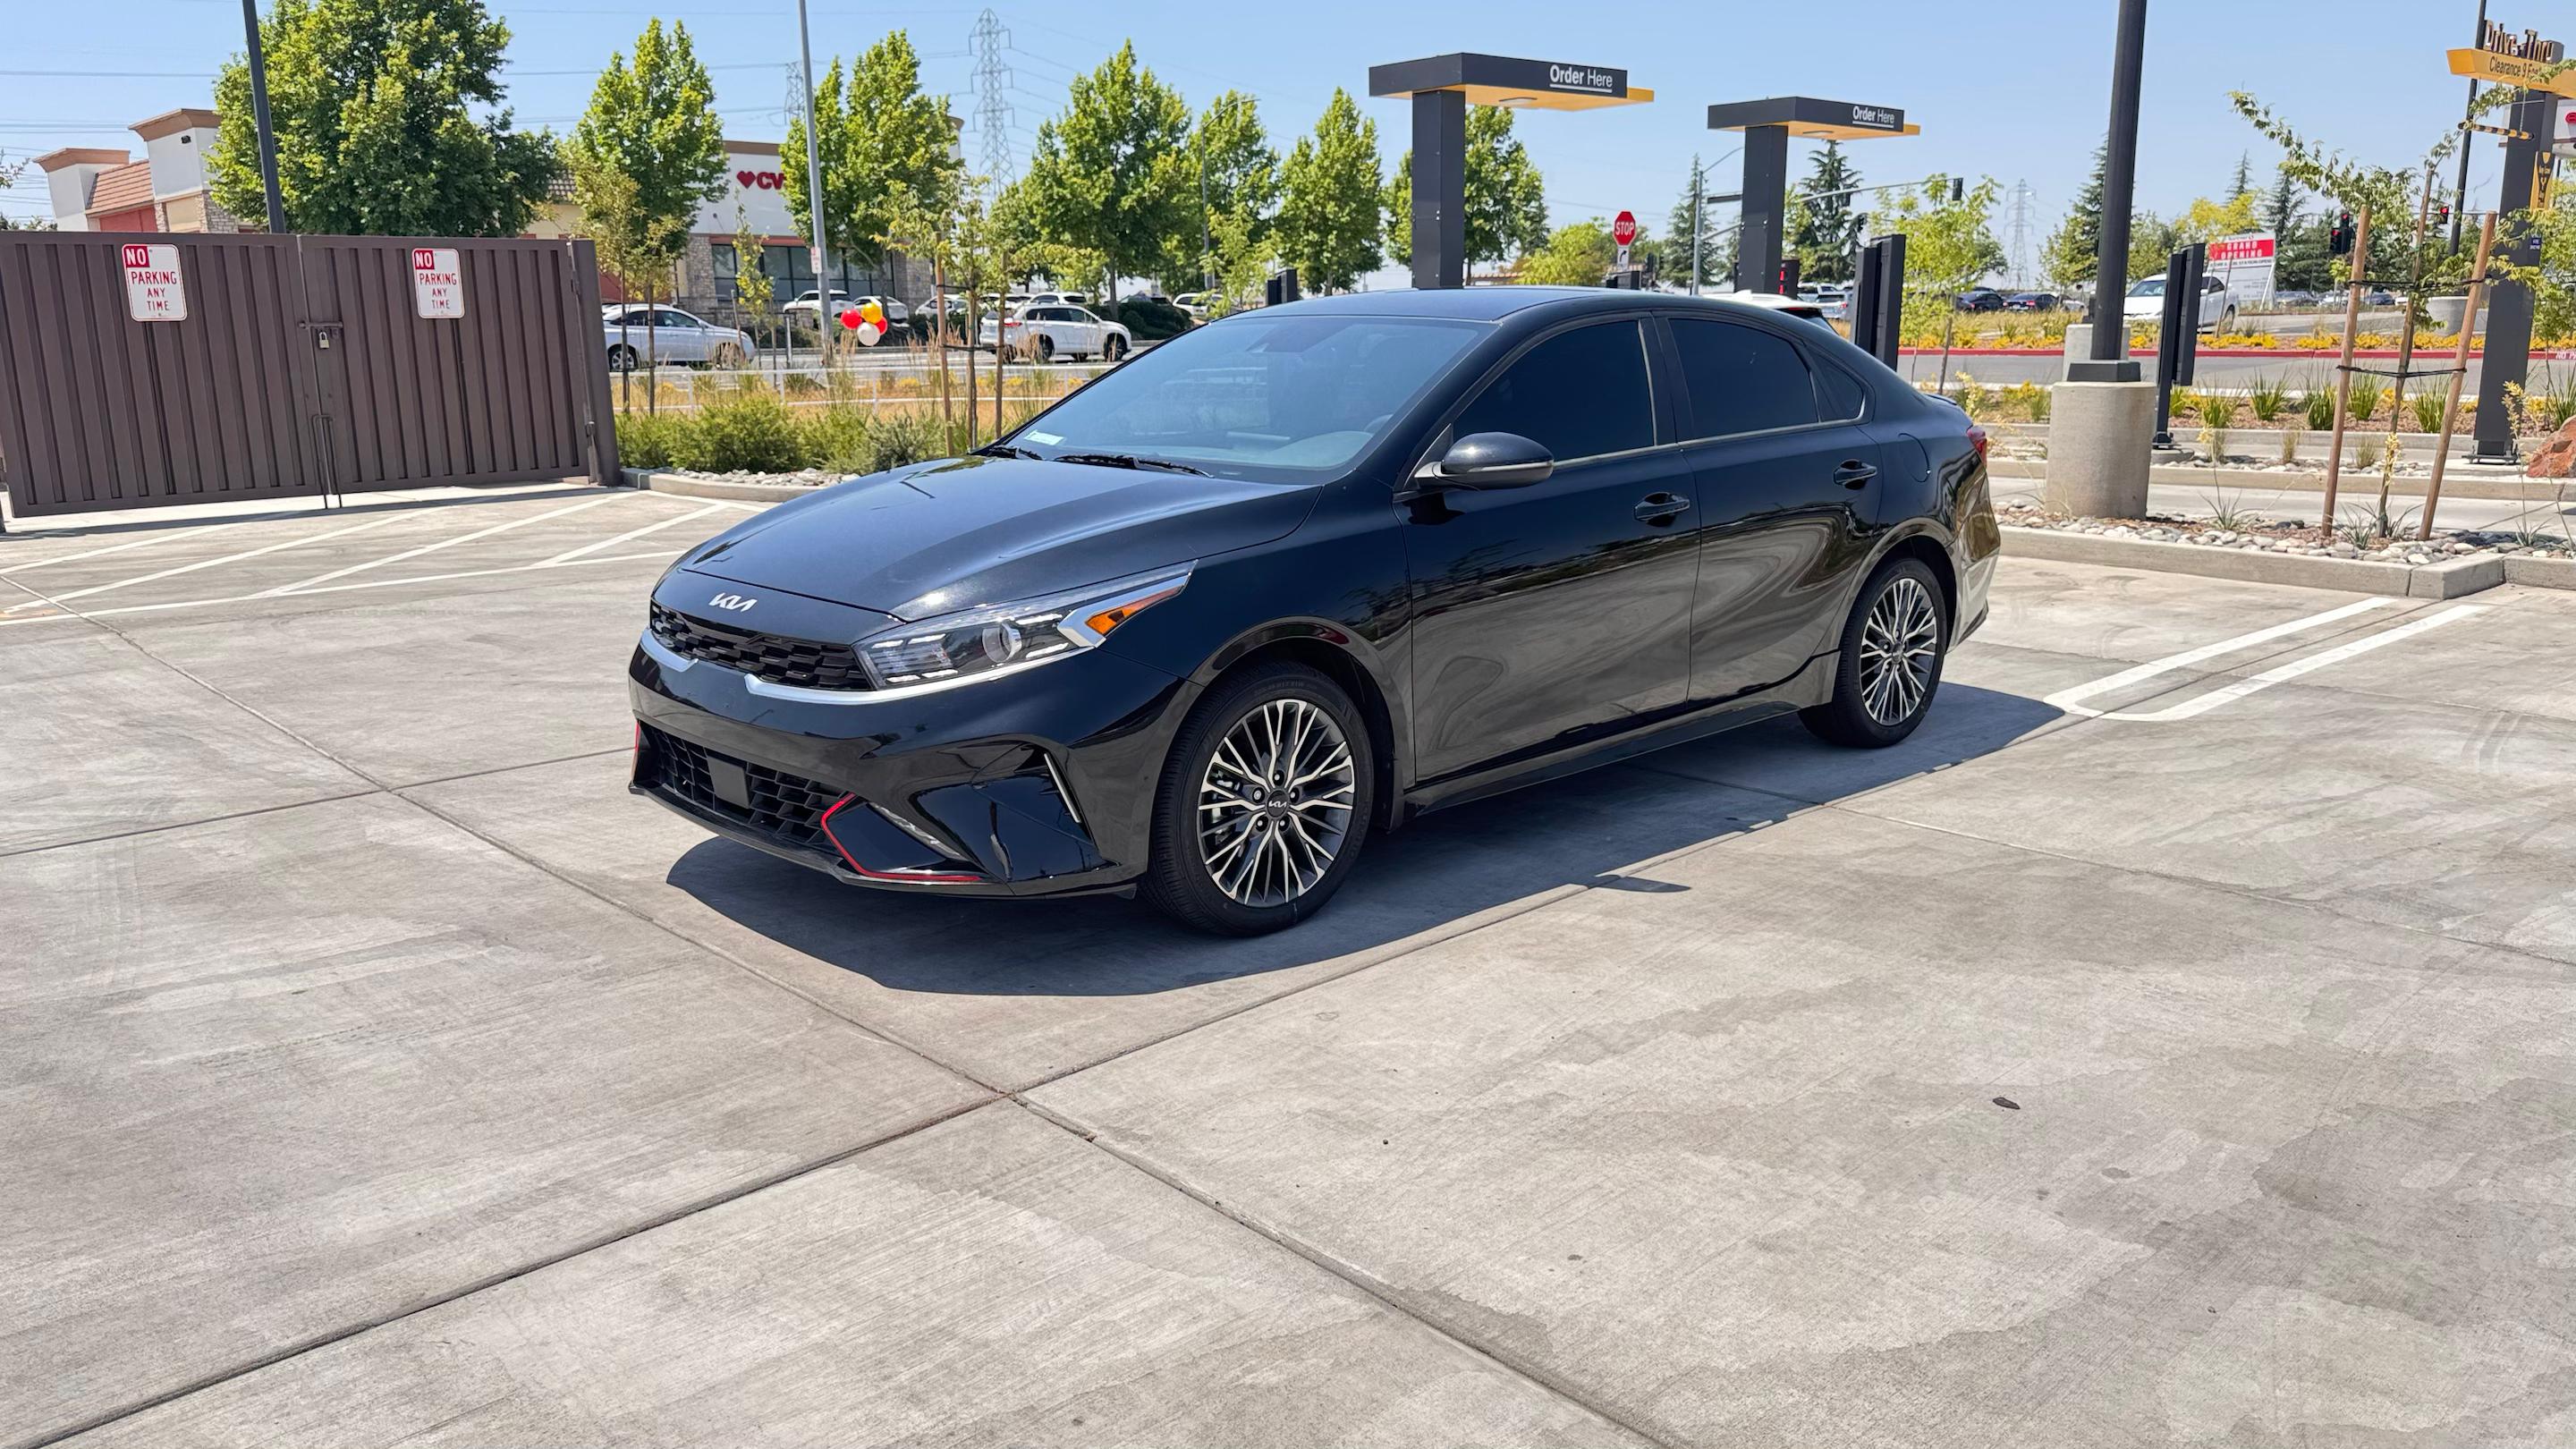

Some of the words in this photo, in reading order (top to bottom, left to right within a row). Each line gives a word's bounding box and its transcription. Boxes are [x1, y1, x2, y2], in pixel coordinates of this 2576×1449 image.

[2484, 20, 2560, 64] Drive-Thru
[2489, 55, 2521, 77] Clearance
[2521, 62, 2527, 77] 9
[1550, 64, 1584, 85] Order
[1587, 68, 1613, 88] Here
[1852, 106, 1876, 122] Order
[1877, 108, 1894, 124] Here
[757, 172, 786, 190] CV
[1615, 221, 1634, 236] STOP
[2226, 241, 2258, 250] GRAND
[126, 248, 147, 266] NO
[415, 251, 433, 267] NO
[2221, 249, 2262, 259] OPENING
[131, 271, 177, 284] PARKING
[419, 273, 457, 285] PARKING
[147, 287, 165, 298] ANY
[432, 288, 447, 297] ANY
[147, 301, 170, 311] TIME
[431, 300, 451, 309] TIME
[708, 592, 758, 613] KIA
